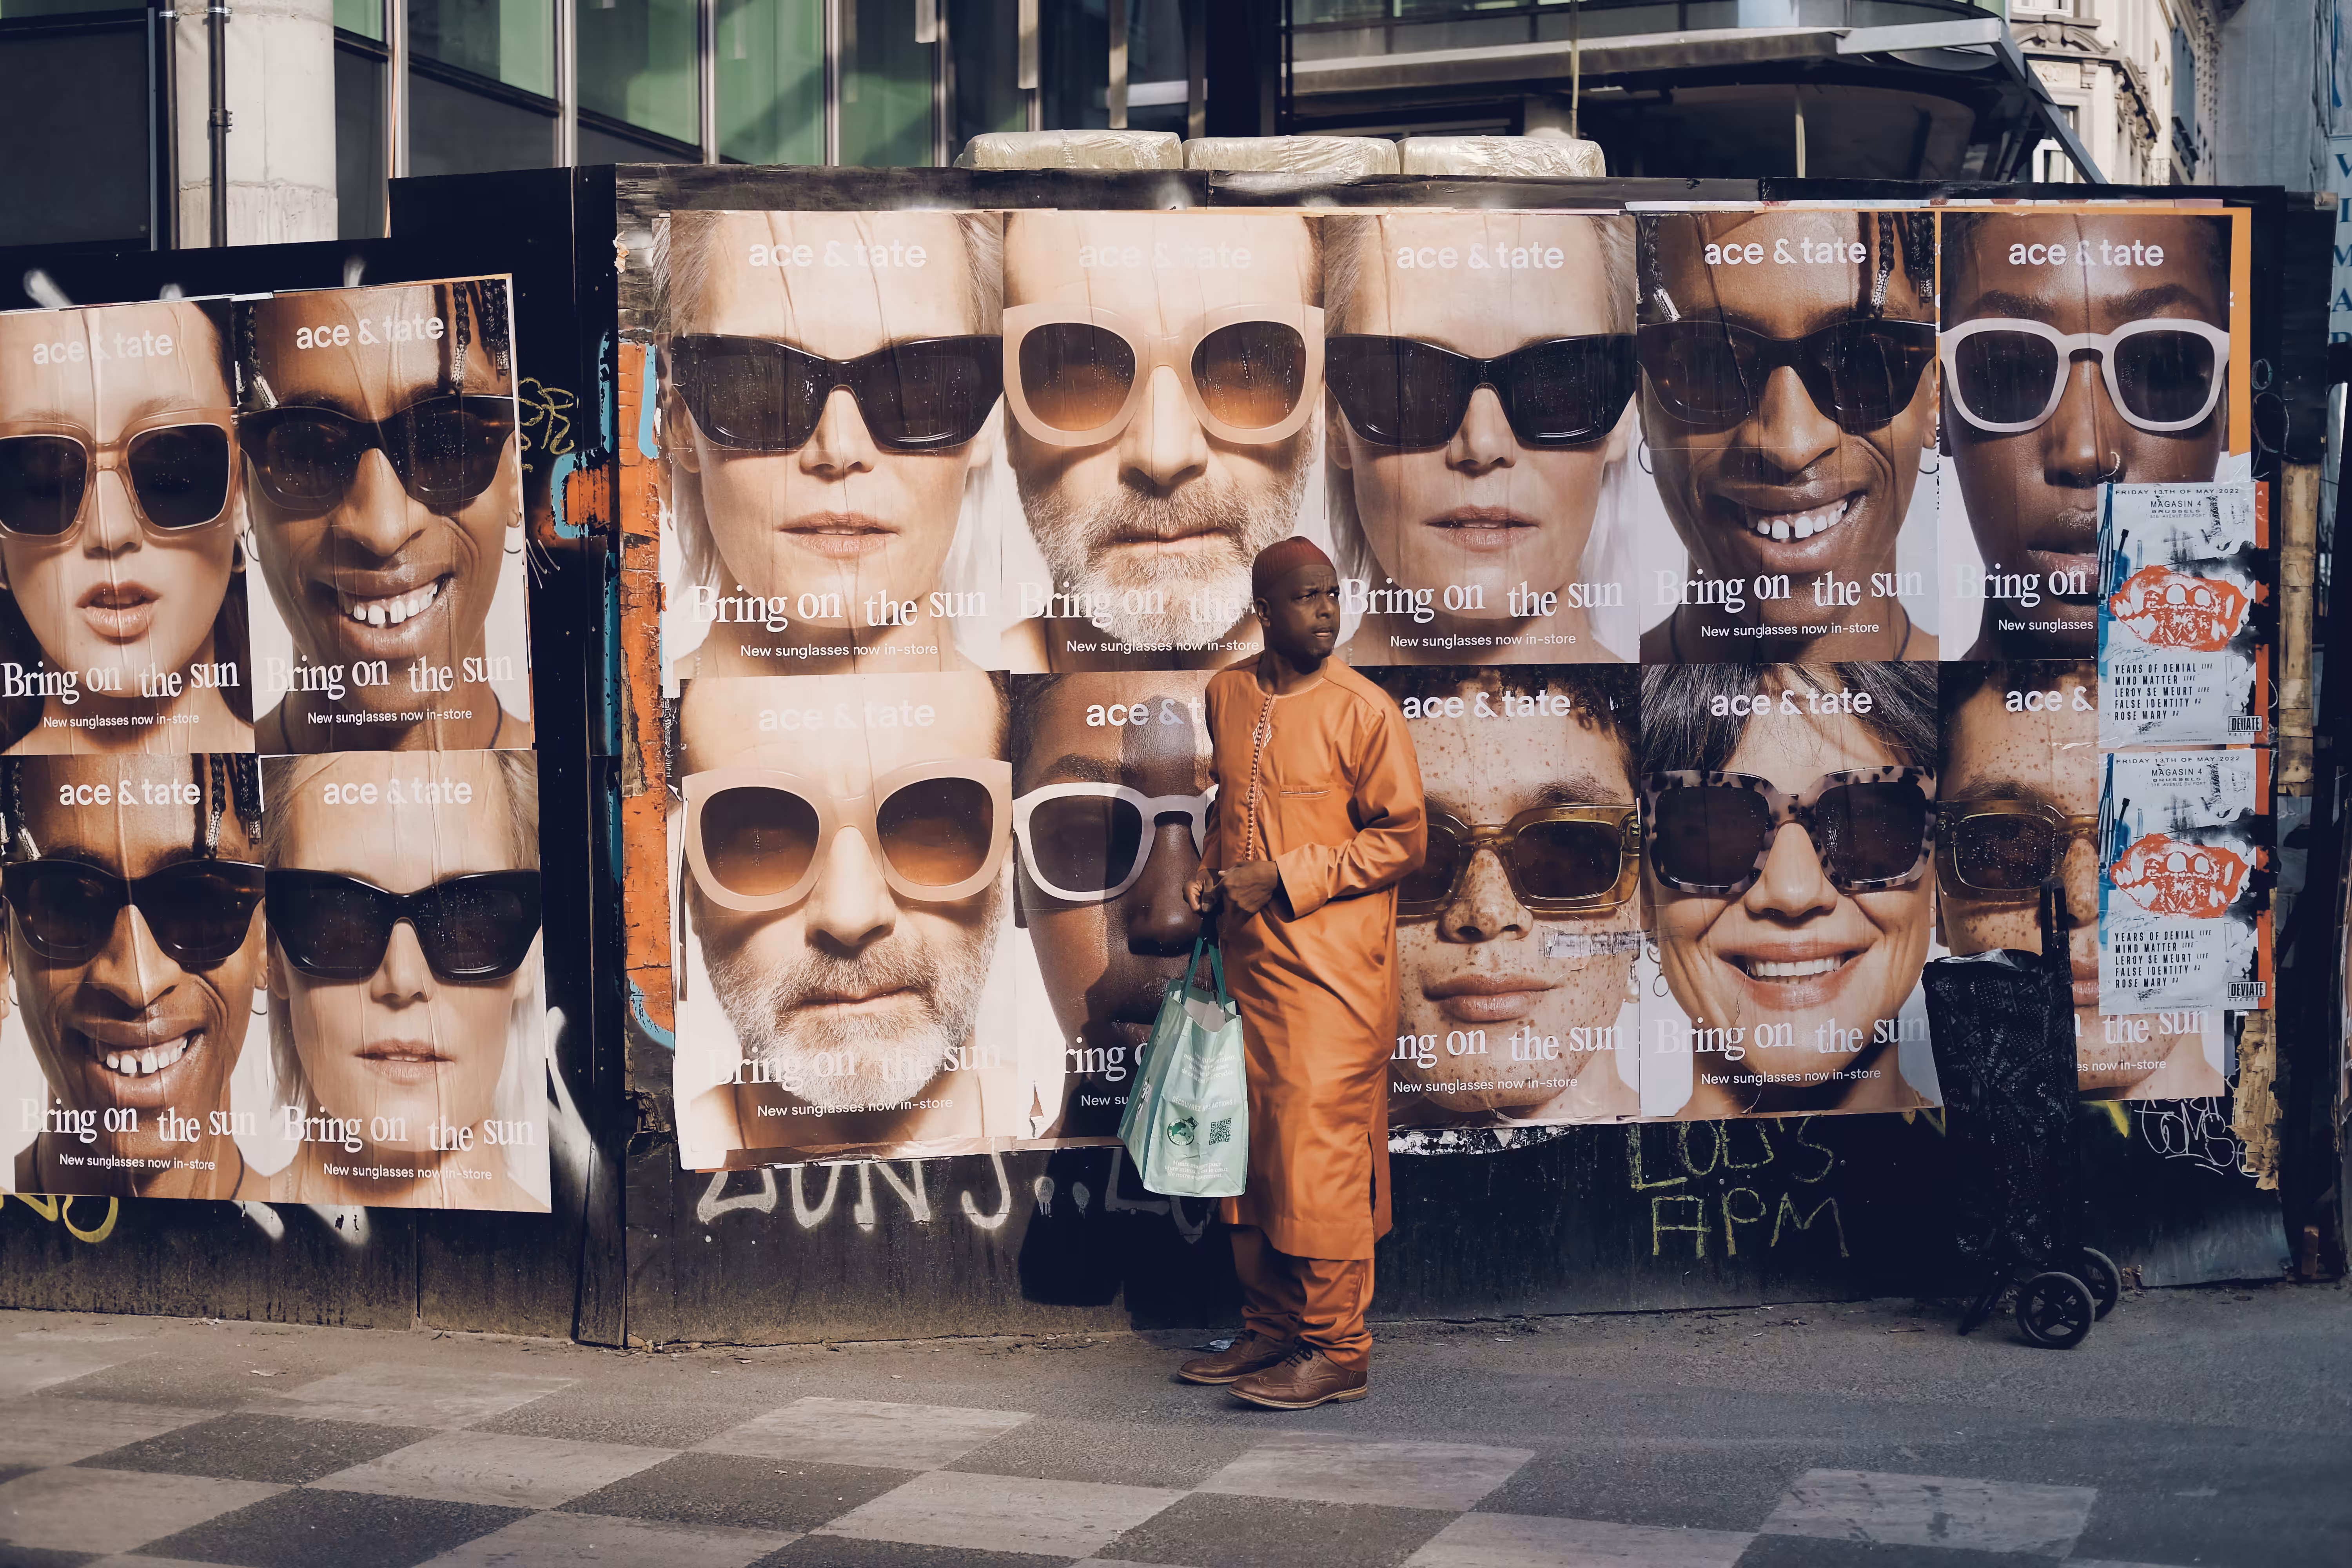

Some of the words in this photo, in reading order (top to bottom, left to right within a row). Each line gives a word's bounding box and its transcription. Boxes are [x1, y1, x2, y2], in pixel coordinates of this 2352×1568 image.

[1704, 243, 1764, 265] ace
[1773, 238, 1797, 264] &
[1800, 237, 1866, 264] tate
[296, 324, 350, 349] ace
[357, 318, 380, 345] &
[383, 313, 444, 343] tate
[1653, 568, 1745, 613] Bring
[1754, 574, 1791, 600] on
[1812, 570, 1861, 606] the
[1871, 570, 1925, 598] sun
[1952, 563, 2041, 608] Bring
[2049, 570, 2088, 595] on
[1701, 626, 1730, 637] New
[1733, 624, 1798, 639] sunglasses
[1801, 625, 1828, 635] now
[1831, 622, 1879, 634] in-store
[1999, 619, 2025, 630] New
[2029, 618, 2094, 633] sunglasses
[1067, 640, 1096, 652] New
[1101, 639, 1172, 655] sunglasses
[1176, 642, 1203, 652] now
[1207, 639, 1259, 651] in-store
[1390, 635, 1419, 647] New
[1422, 634, 1492, 650] sunglasses
[1496, 635, 1522, 646] now
[1526, 633, 1576, 645] in-store
[2115, 665, 2143, 674] YEARS
[2149, 664, 2158, 673] OF
[2164, 663, 2196, 673] DENIAL
[0, 661, 79, 704] Bring
[86, 667, 122, 692] on
[139, 662, 182, 699] the
[190, 661, 240, 688] sun
[2115, 676, 2137, 686] MIND
[2143, 675, 2178, 685] MATTER
[2006, 690, 2062, 712] ace
[2072, 686, 2094, 711] &
[2115, 688, 2141, 697] LEROY
[2147, 687, 2157, 696] SE
[2164, 686, 2192, 696] MEURT
[1403, 696, 1464, 719] ace
[1474, 692, 1498, 718] &
[1502, 690, 1570, 717] tate
[2115, 700, 2141, 709] FALSE
[2147, 698, 2189, 708] IDENTITY
[44, 716, 67, 728] New
[70, 714, 129, 730] sunglasses
[131, 714, 153, 725] now
[156, 712, 200, 725] in-store
[308, 711, 332, 724] New
[336, 710, 397, 726] sunglasses
[400, 711, 423, 722] now
[426, 709, 472, 720] in-store
[2115, 711, 2136, 720] ROSE
[2143, 710, 2167, 720] MARY
[2232, 717, 2260, 731] DEVIATE
[2115, 932, 2144, 942] YEARS
[2150, 931, 2159, 941] OF
[2164, 930, 2194, 940] DENIAL
[2116, 944, 2138, 953] MIND
[2144, 942, 2177, 953] MATTER
[2116, 955, 2143, 965] LEROY
[2149, 955, 2157, 964] SE
[2163, 953, 2191, 963] MEURT
[2116, 967, 2141, 976] FALSE
[2147, 965, 2189, 975] IDENTITY
[2116, 979, 2138, 988] ROSE
[2144, 977, 2167, 987] MARY
[2231, 983, 2263, 996] DEVIATE
[2102, 1015, 2149, 1044] the
[2160, 1011, 2211, 1035] sun
[1446, 1026, 1488, 1055] on
[1509, 1025, 1559, 1061] the
[1570, 1024, 1626, 1052] sun
[1653, 1017, 1745, 1062] Bring
[1754, 1022, 1795, 1048] on
[1815, 1018, 1863, 1054] the
[1873, 1017, 1929, 1045] sun
[1064, 1037, 1127, 1082] ring
[2092, 1062, 2117, 1071] now
[2121, 1059, 2167, 1071] in-store
[1702, 1073, 1730, 1085] New
[1733, 1072, 1801, 1086] sunglasses
[1805, 1072, 1829, 1082] now
[1833, 1069, 1881, 1080] in-store
[757, 1104, 788, 1117] New
[791, 1102, 864, 1118] sunglasses
[868, 1101, 896, 1112] now
[901, 1098, 953, 1111] in-store
[1081, 1094, 1111, 1106] New
[1172, 1094, 1201, 1112] DÉCOUVREZ
[1212, 1099, 1232, 1109] ACTIONS
[18, 1098, 97, 1143] Bring
[104, 1107, 139, 1133] on
[157, 1106, 201, 1143] the
[209, 1109, 258, 1136] sun
[60, 1154, 84, 1166] New
[87, 1155, 144, 1170] sunglasses
[148, 1159, 171, 1169] now
[174, 1157, 215, 1170] in-store
[324, 1163, 349, 1176] New
[353, 1165, 414, 1180] sunglasses
[417, 1169, 441, 1179] now
[445, 1168, 492, 1180] in-store
